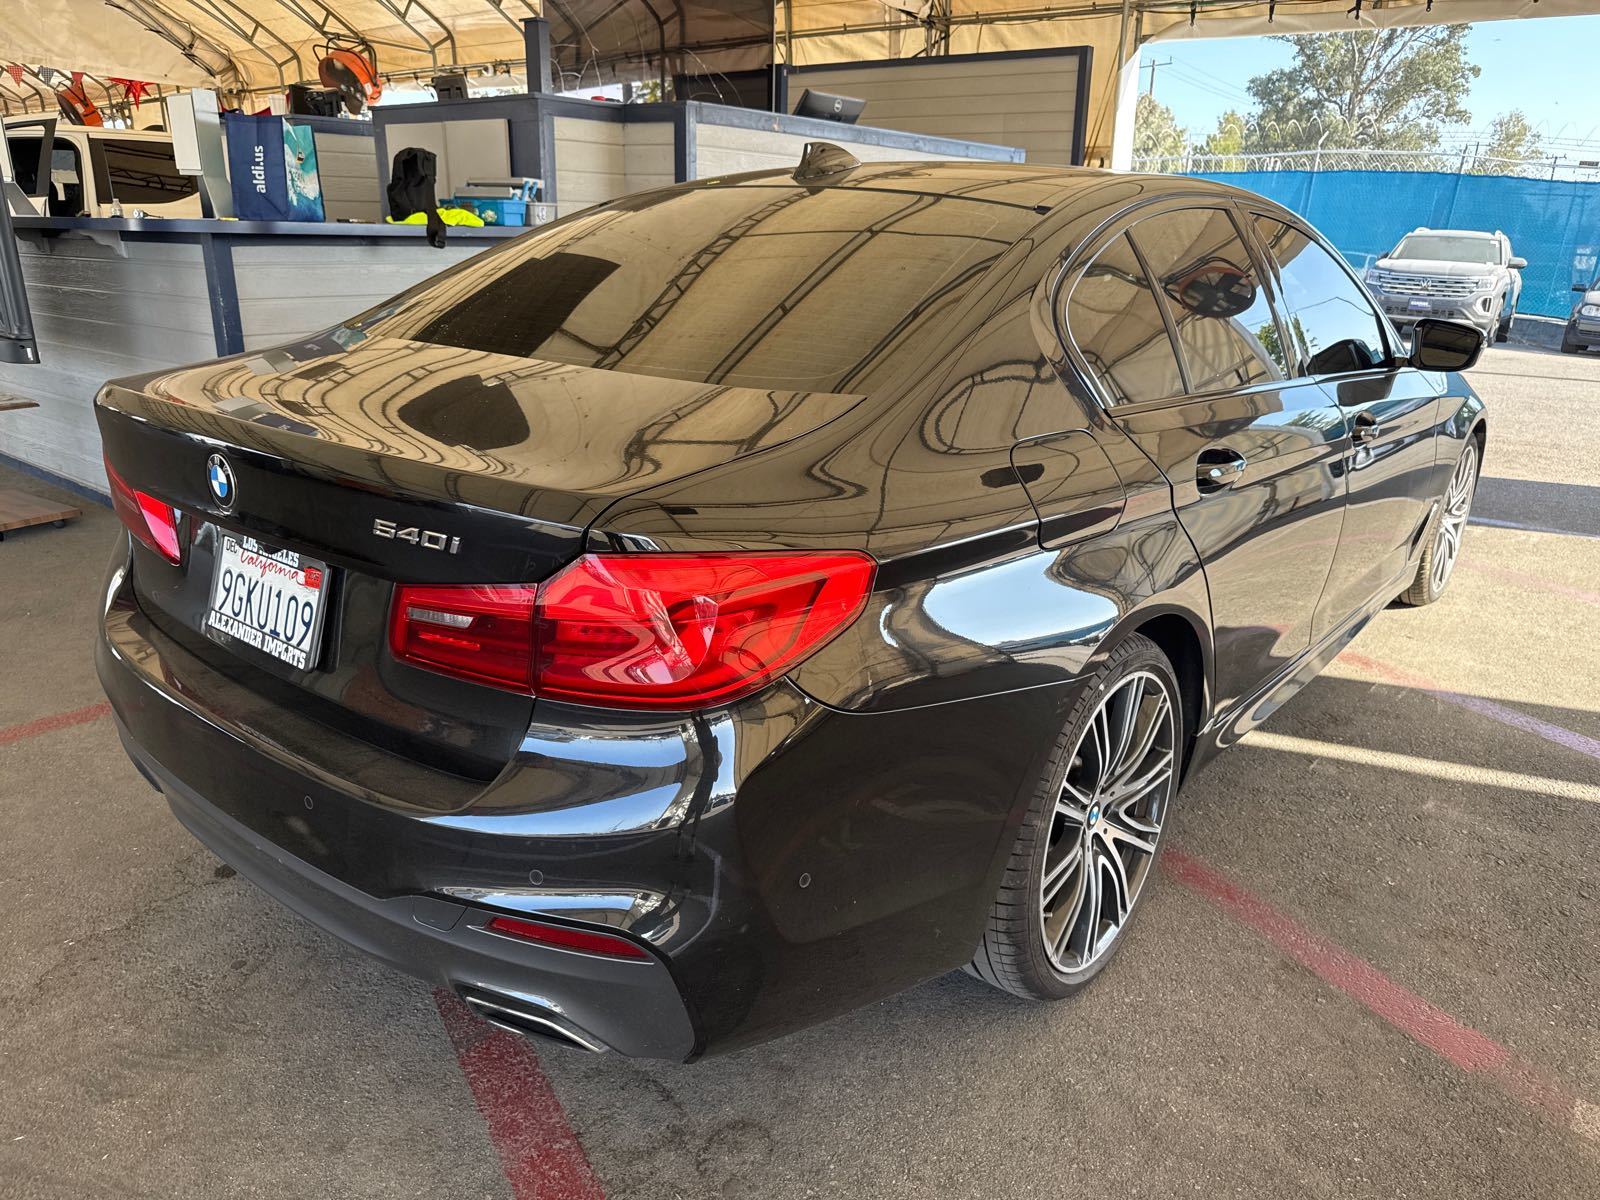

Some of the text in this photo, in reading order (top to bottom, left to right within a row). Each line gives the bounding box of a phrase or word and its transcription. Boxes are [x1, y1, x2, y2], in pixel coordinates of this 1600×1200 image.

[251, 145, 266, 193] aldi.us
[242, 535, 258, 552] LOS
[373, 518, 461, 554] 540i
[240, 550, 305, 586] California
[218, 567, 314, 648] 9GKU109
[207, 610, 263, 649] ALEXANDER
